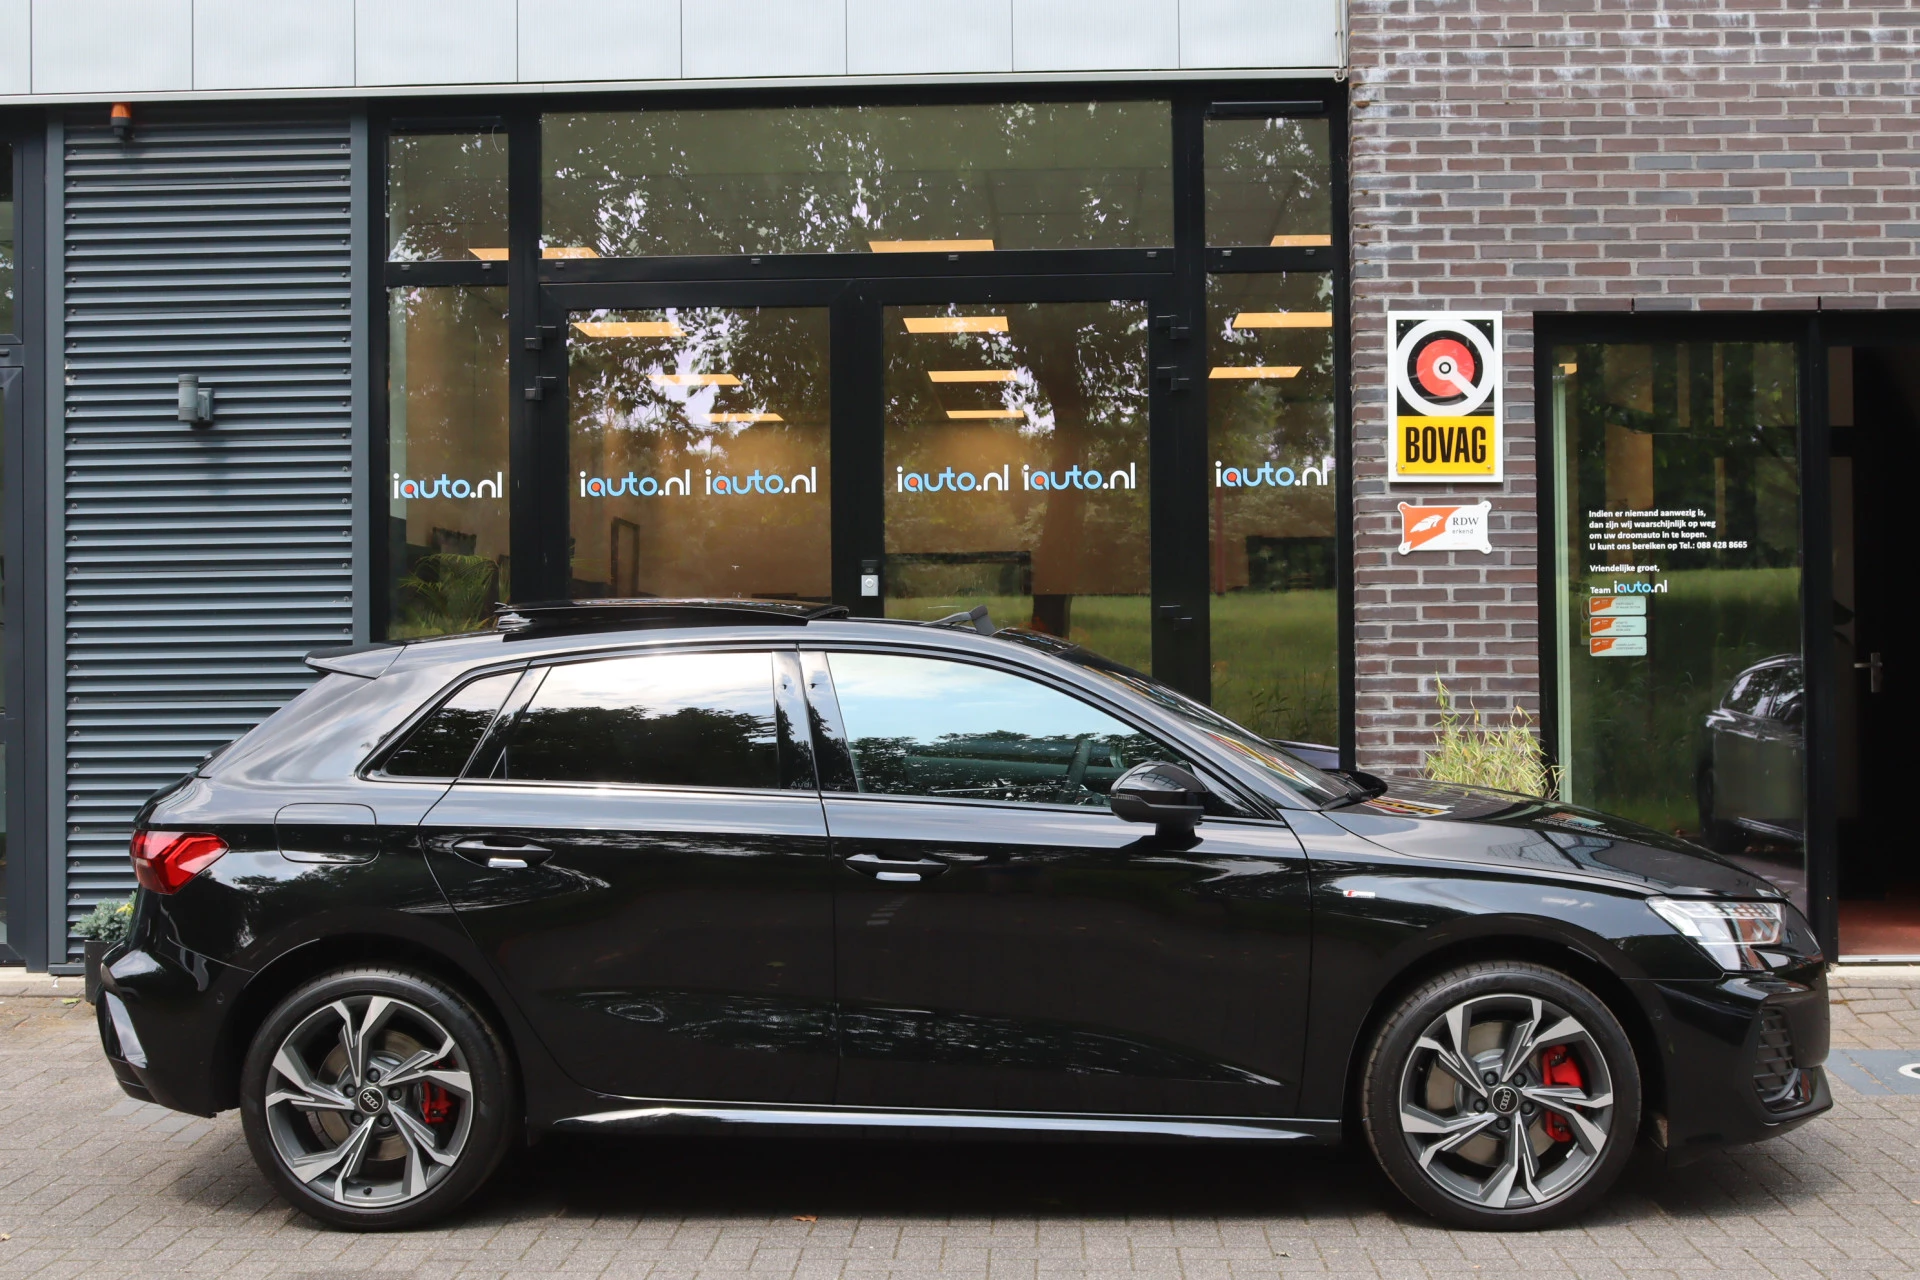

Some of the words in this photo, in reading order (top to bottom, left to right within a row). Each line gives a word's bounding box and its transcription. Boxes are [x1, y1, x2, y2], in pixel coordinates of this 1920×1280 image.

[1405, 426, 1487, 464] BOVAG
[896, 464, 1009, 493] iauto.nl
[1023, 462, 1136, 491] iauto.nl
[1214, 460, 1329, 488] iauto.nl
[393, 471, 503, 499] iauto.nl
[579, 469, 691, 498] iauto.nl
[705, 466, 817, 495] iauto.nl
[1588, 510, 1613, 518] Indien
[1624, 509, 1659, 517] niemand
[1660, 509, 1696, 518] aanwezig
[1697, 508, 1706, 517] is,
[1452, 517, 1479, 526] RDW
[1589, 521, 1604, 529] dan
[1605, 521, 1619, 530] zijn
[1620, 520, 1633, 530] wij
[1634, 519, 1686, 529] waarschijnlijk
[1700, 520, 1716, 529] weg
[1617, 531, 1660, 539] droomauto
[1662, 530, 1670, 539] in
[1671, 531, 1680, 539] te
[1681, 530, 1708, 540] kopen.
[1589, 542, 1596, 551] U
[1597, 542, 1615, 550] kunt
[1632, 541, 1666, 550] bereiken
[1667, 543, 1678, 551] op
[1679, 541, 1695, 549] Tel.:
[1696, 541, 1711, 549] 088
[1712, 541, 1727, 549] 428
[1728, 540, 1748, 549] 8665
[1589, 564, 1636, 573] Vriendelijke
[1637, 563, 1660, 573] groet,
[1590, 586, 1611, 594] Team
[1613, 579, 1668, 594] iauto.nl
